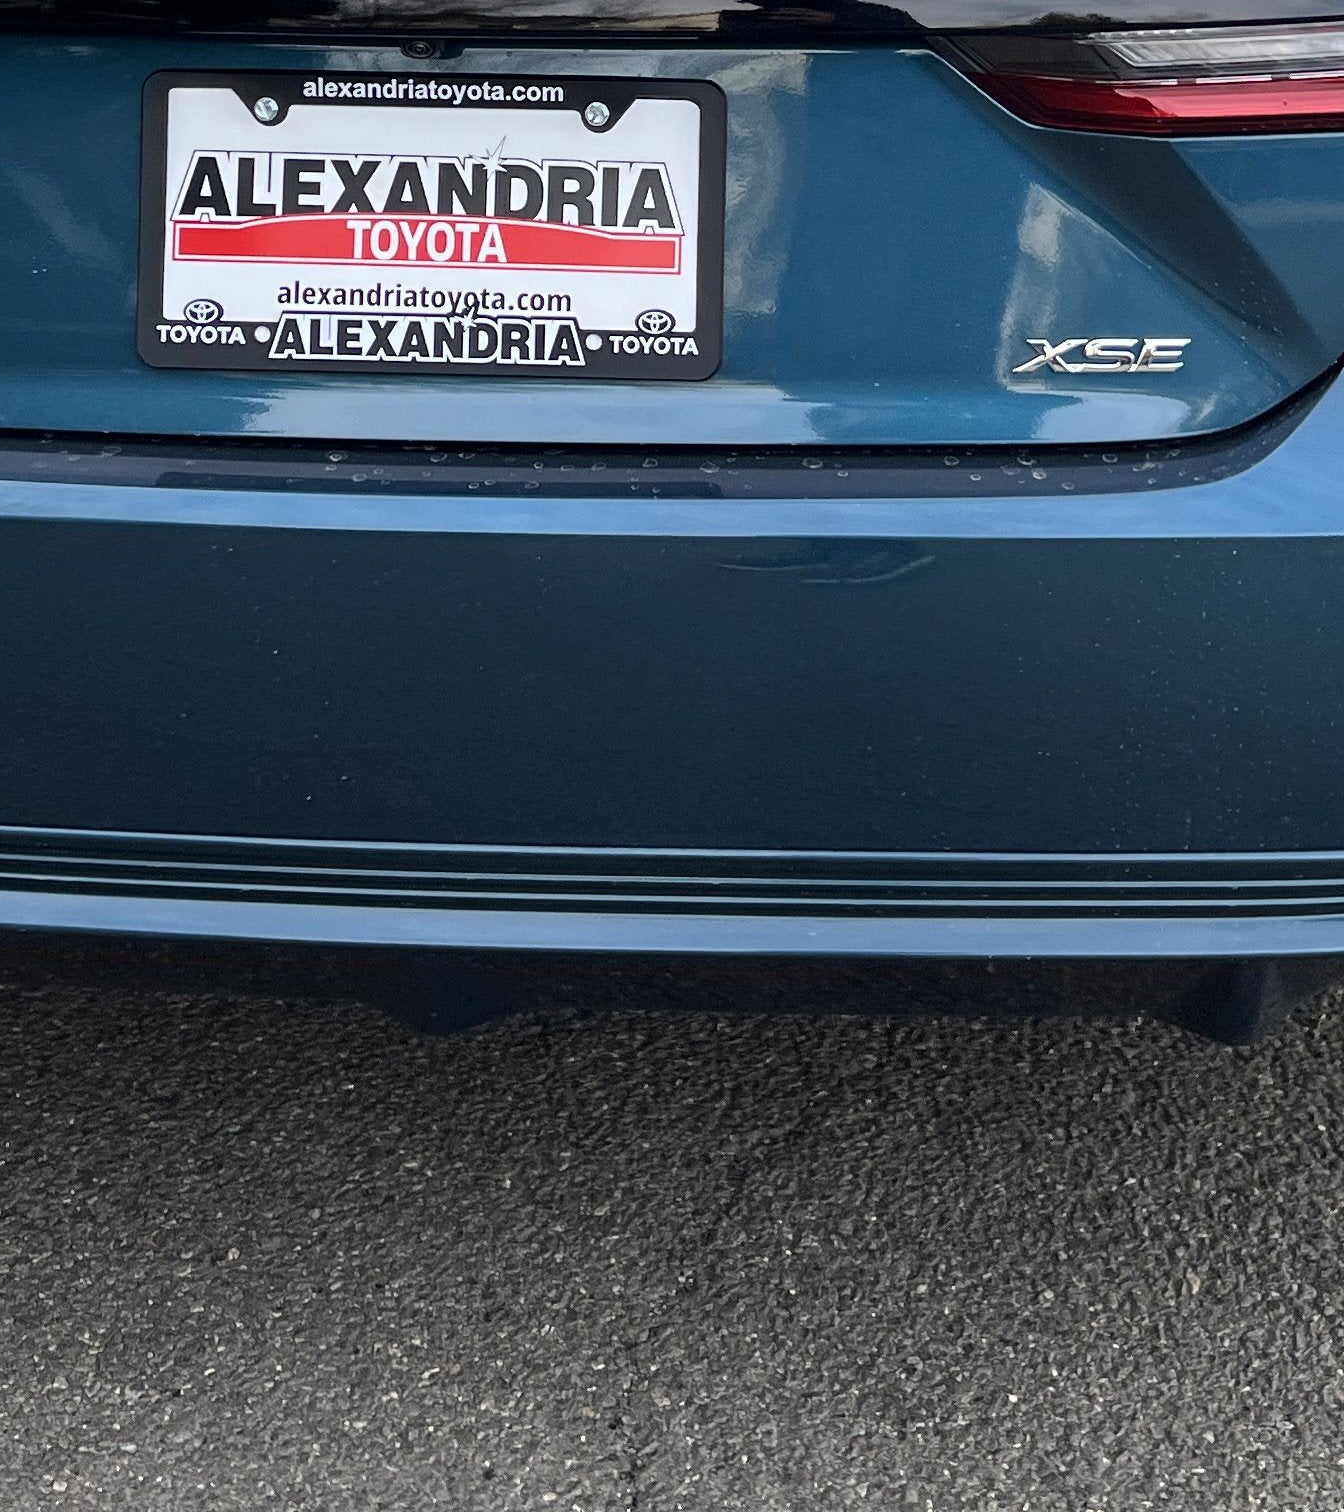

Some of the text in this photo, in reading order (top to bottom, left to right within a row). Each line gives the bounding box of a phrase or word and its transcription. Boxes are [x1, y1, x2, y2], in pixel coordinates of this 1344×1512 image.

[302, 77, 565, 105] alexandriatoyota.com
[178, 154, 677, 230] ALEXANDRIA
[346, 219, 508, 263] TOYOTA
[276, 281, 573, 313] alexandriatoyota.com
[156, 312, 700, 366] TOYOTA ALEXANDRIA TOYOTA
[1011, 337, 1192, 373] XSE
